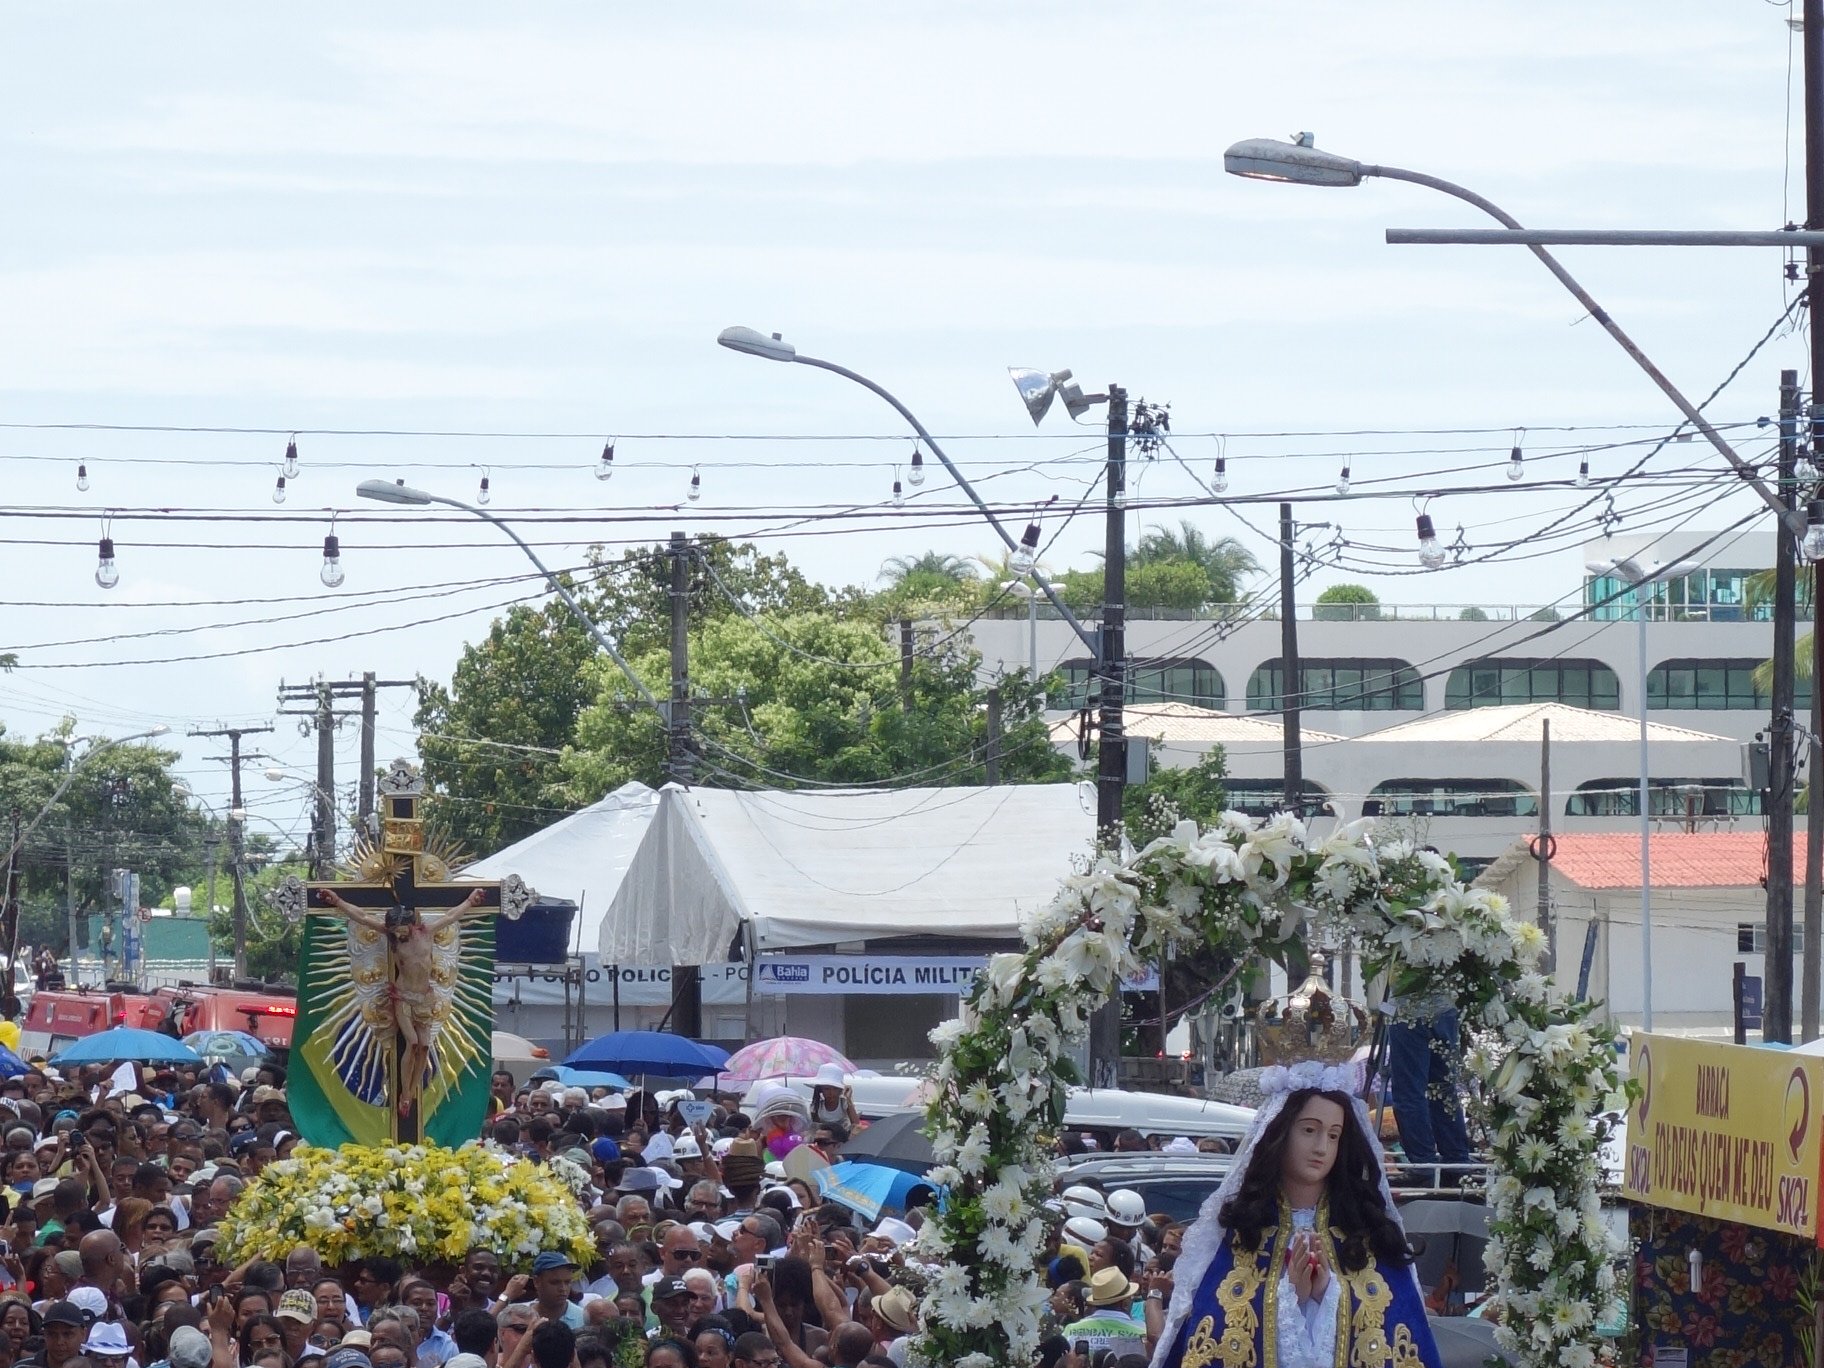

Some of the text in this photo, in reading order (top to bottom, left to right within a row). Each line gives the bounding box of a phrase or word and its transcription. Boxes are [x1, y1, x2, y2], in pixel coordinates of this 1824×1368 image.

[777, 966, 808, 976] Bahia
[822, 963, 906, 984] POLÍCIA
[1696, 1063, 1729, 1120] BARRACA
[1628, 1144, 1651, 1198] SKOL
[1654, 1122, 1774, 1214] FOI DEUS QUEM ME DEU
[1776, 1175, 1809, 1230] SKOL
